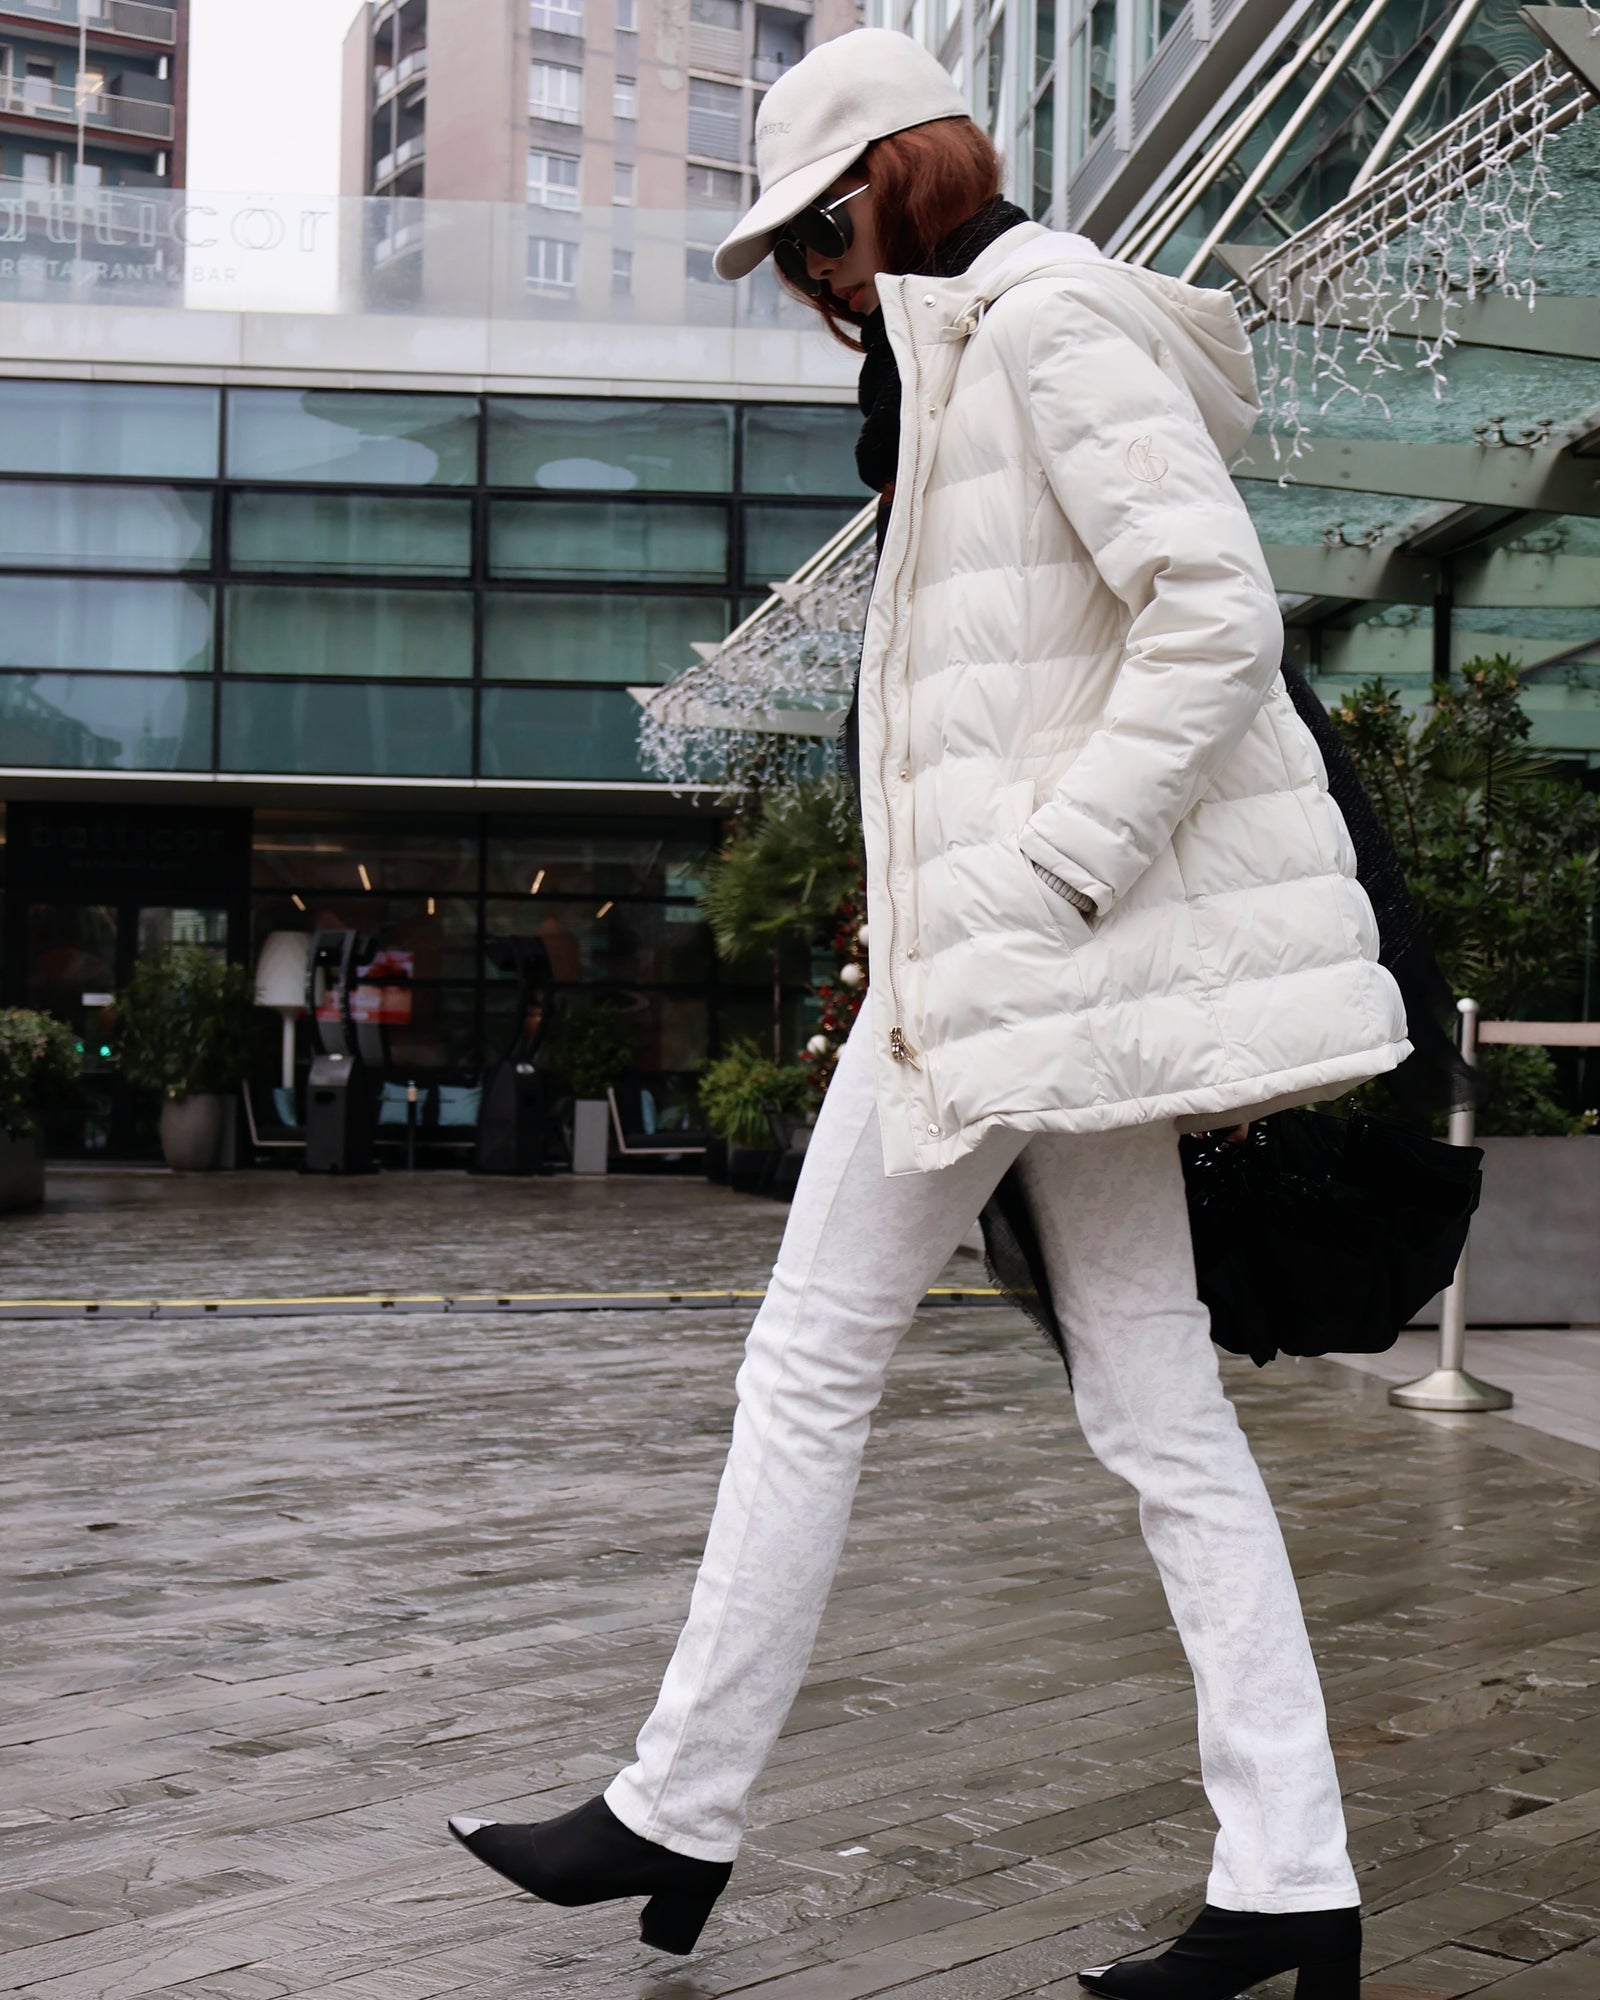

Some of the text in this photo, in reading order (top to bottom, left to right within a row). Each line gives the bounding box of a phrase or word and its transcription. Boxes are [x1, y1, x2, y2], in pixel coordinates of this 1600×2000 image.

[1, 258, 237, 282] RESTARANT & BAR
